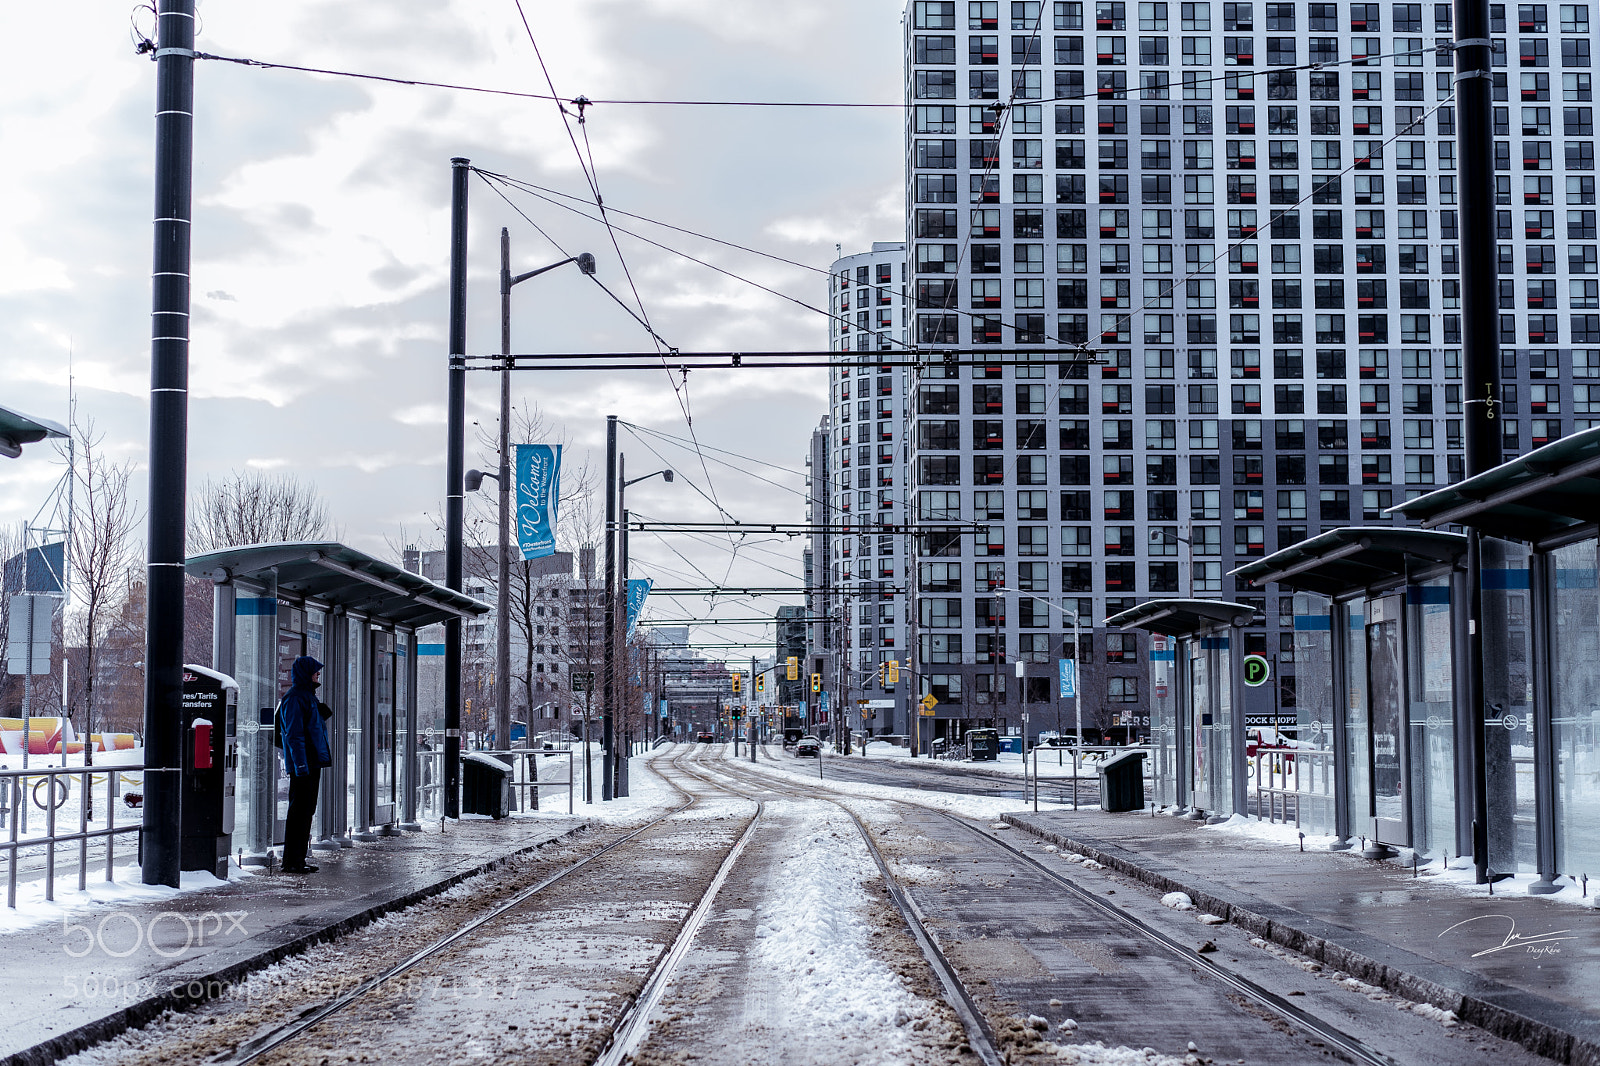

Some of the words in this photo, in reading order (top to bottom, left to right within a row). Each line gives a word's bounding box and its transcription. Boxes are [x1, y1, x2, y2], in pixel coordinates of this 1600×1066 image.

[540, 456, 549, 488] Waterfront
[519, 452, 542, 537] Welcome
[1249, 662, 1260, 680] P
[182, 692, 218, 700] res/Tarifs
[182, 700, 213, 708] ransfers
